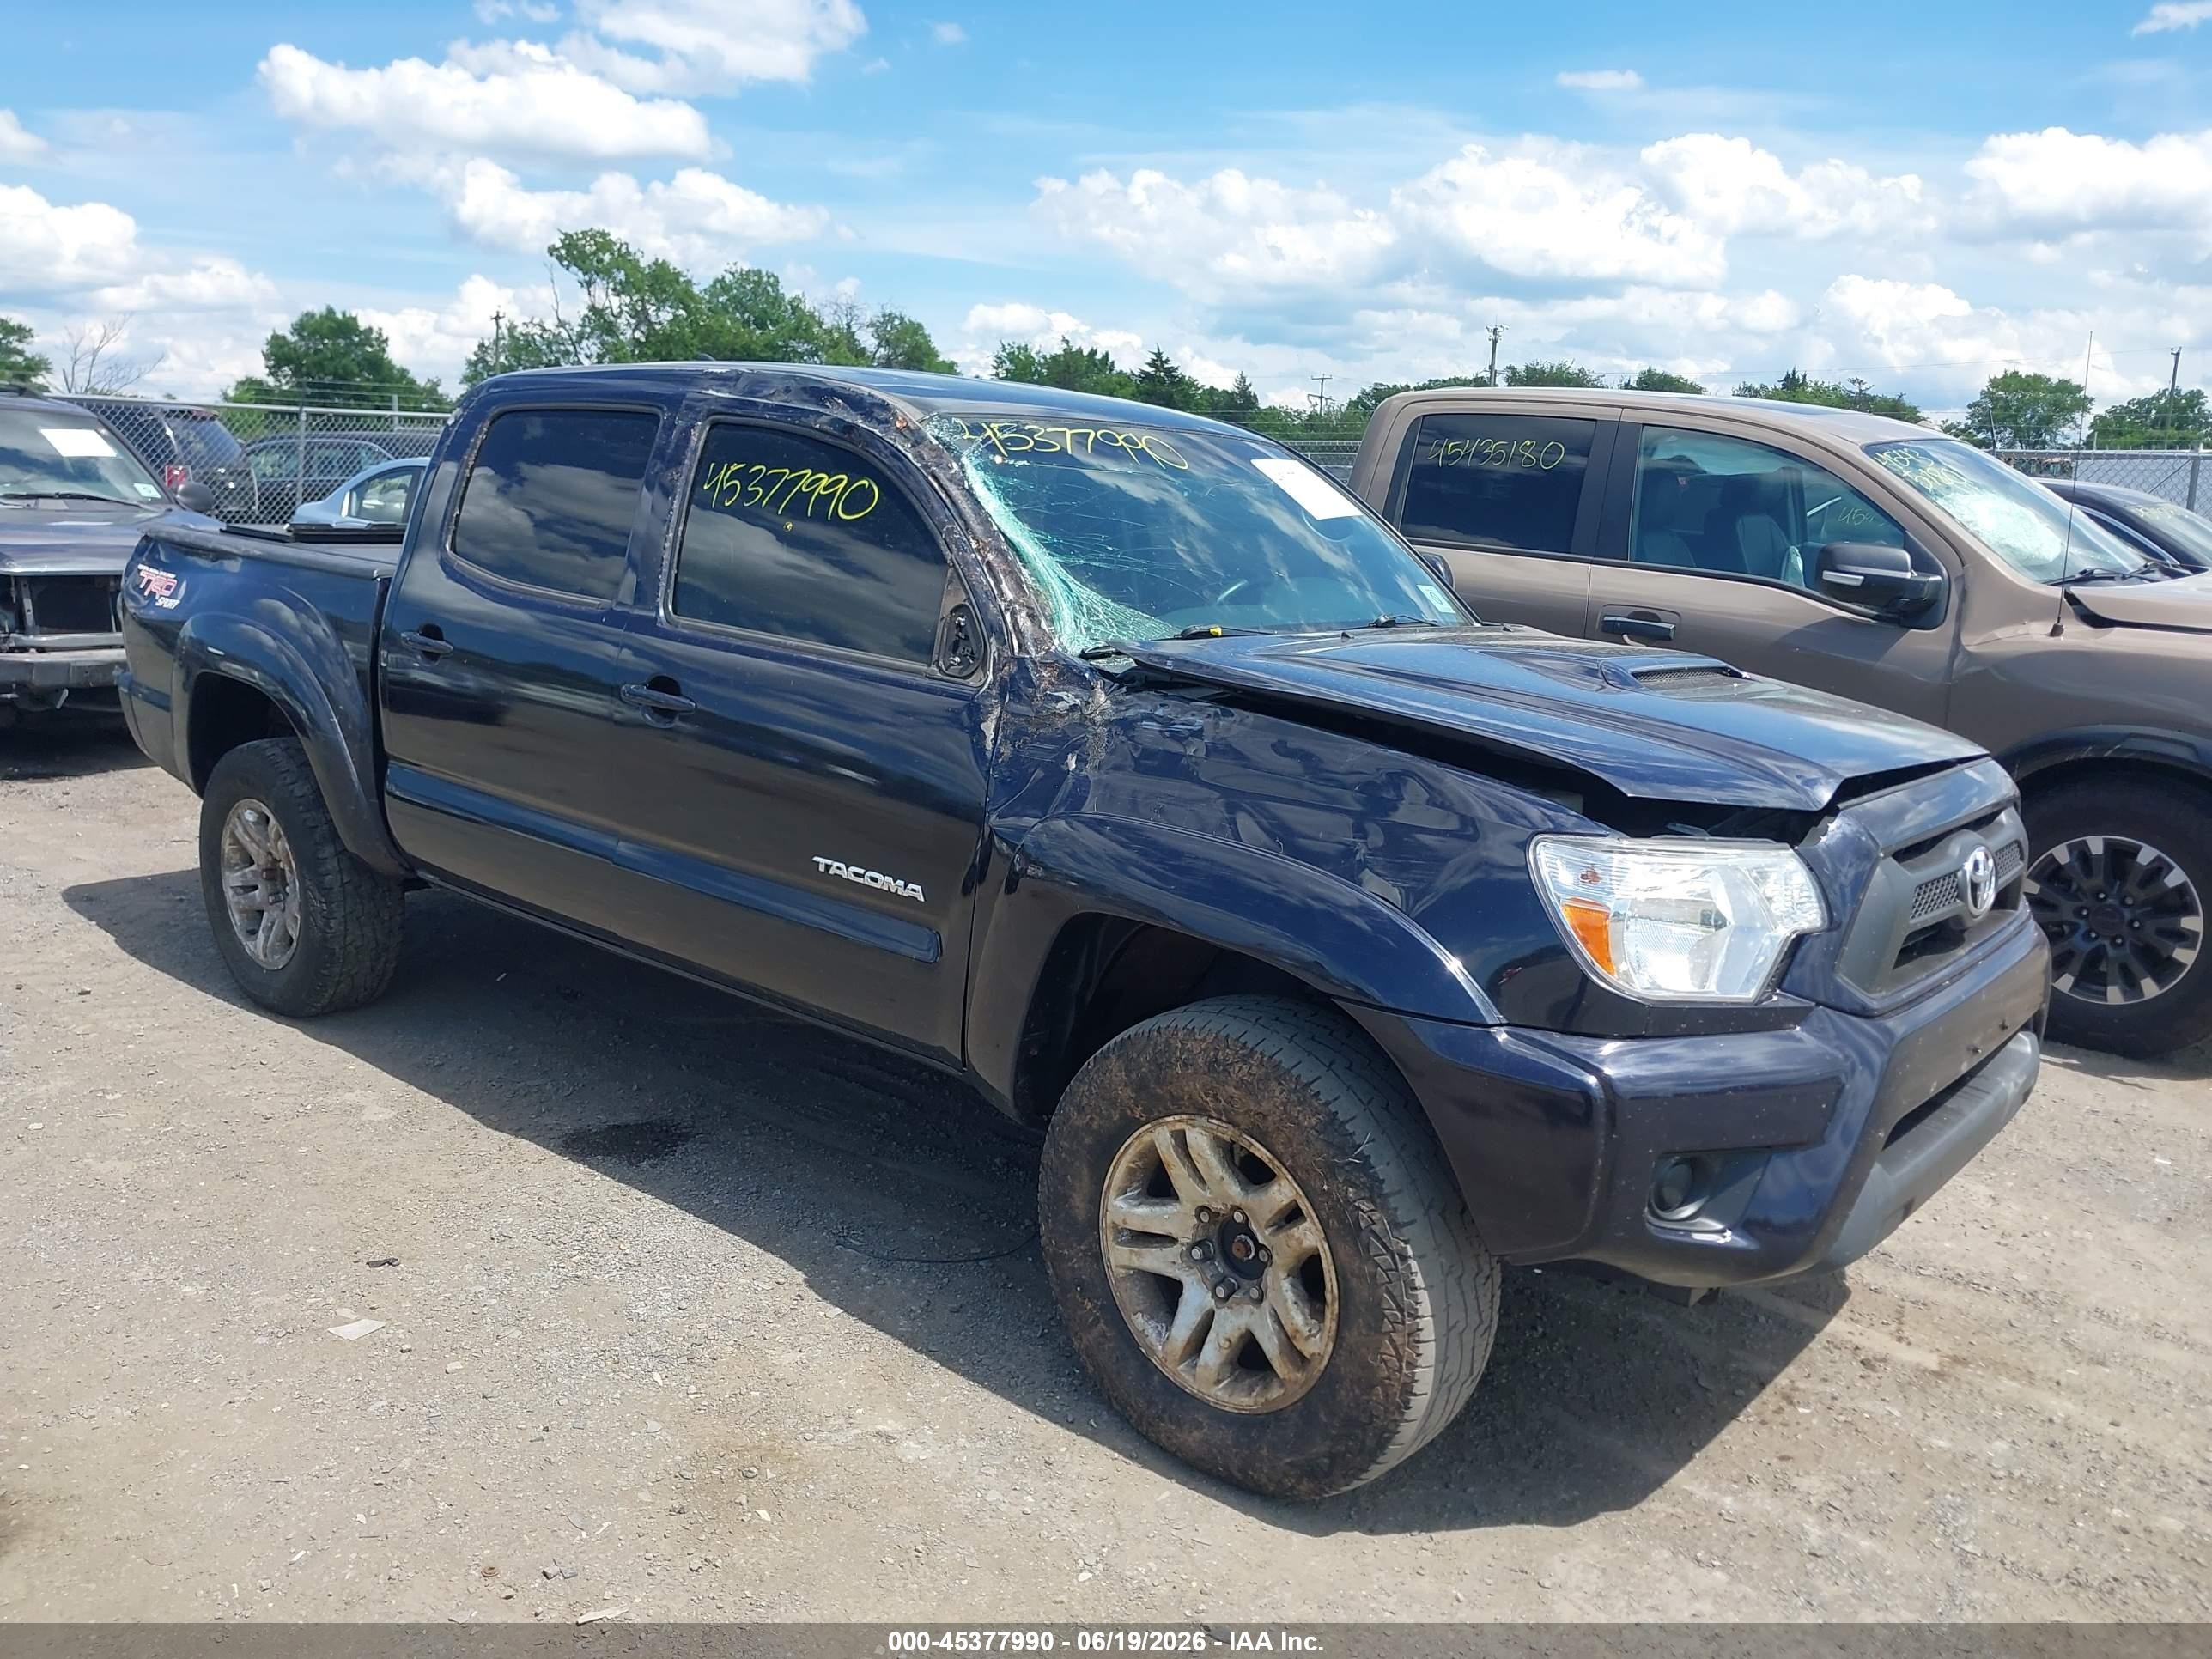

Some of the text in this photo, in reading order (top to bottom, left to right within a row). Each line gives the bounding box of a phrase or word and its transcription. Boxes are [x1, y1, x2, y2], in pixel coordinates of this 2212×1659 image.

[951, 417, 1189, 471] 45377990
[1427, 438, 1565, 470] 45435180
[703, 462, 879, 520] 45377990
[139, 569, 178, 599] TRD
[811, 855, 925, 902] TACOMA
